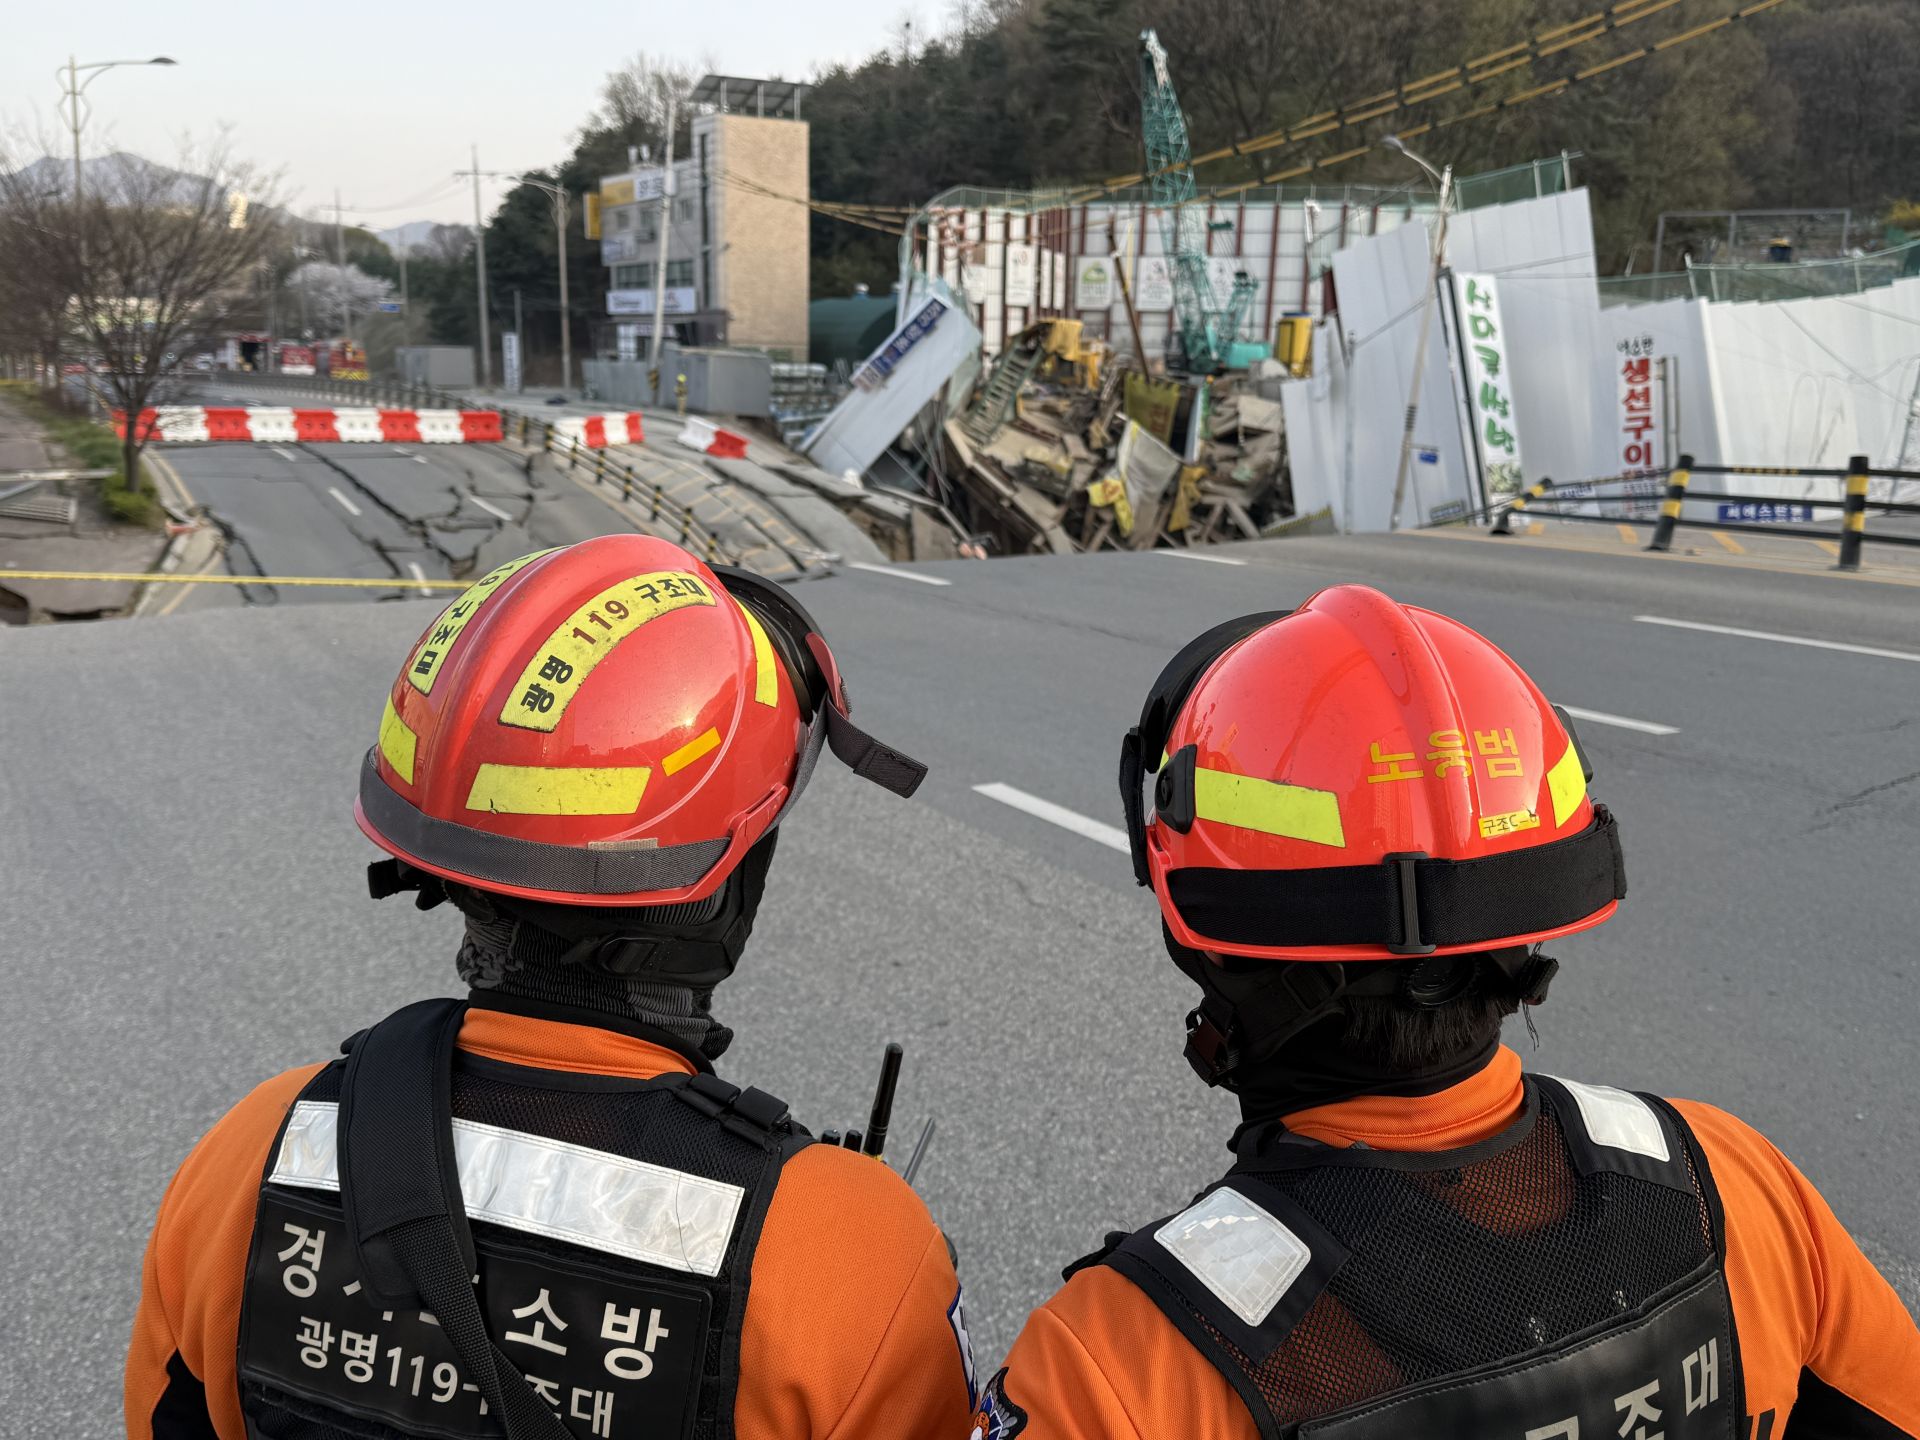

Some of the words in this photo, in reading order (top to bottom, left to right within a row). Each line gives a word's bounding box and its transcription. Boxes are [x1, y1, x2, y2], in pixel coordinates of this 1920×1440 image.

[1621, 357, 1655, 467] 생선구이
[520, 654, 574, 714] 광명
[572, 600, 630, 646] 119
[633, 577, 708, 604] 구조대
